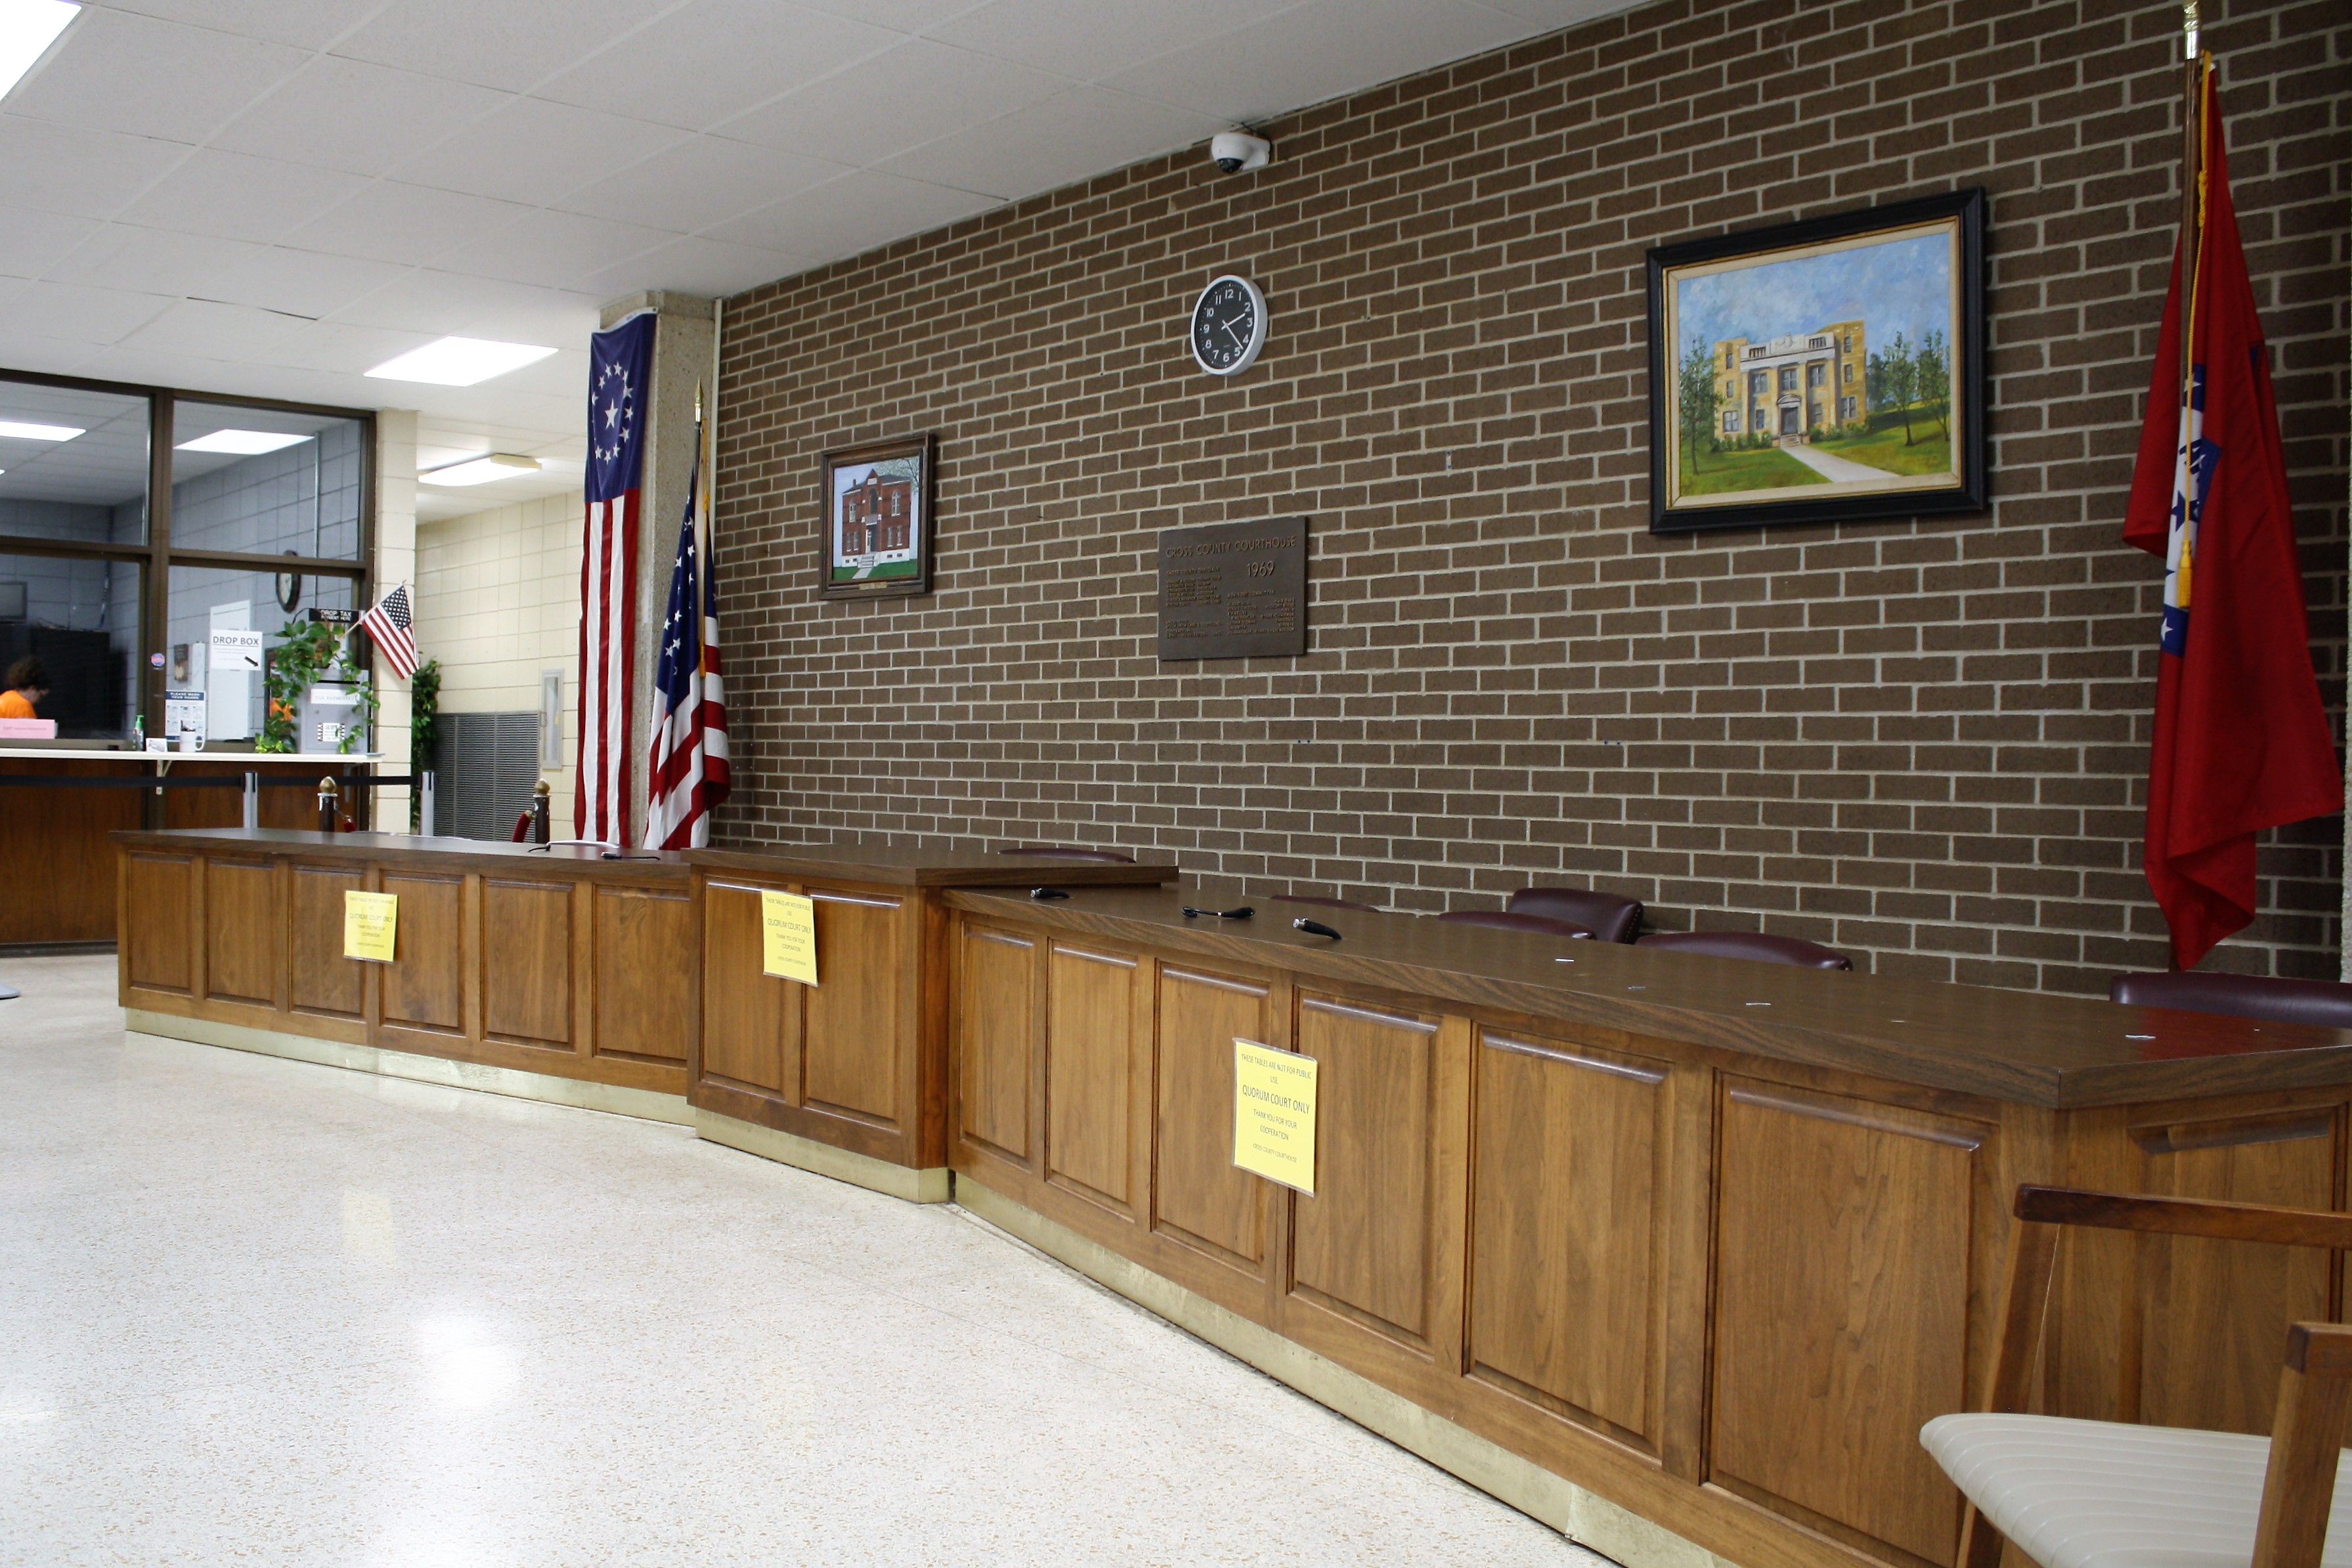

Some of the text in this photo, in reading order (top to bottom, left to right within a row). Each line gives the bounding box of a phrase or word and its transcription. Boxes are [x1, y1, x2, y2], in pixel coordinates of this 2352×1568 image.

[1225, 289, 1234, 299] 12
[1215, 295, 1221, 305] 11
[1244, 302, 1251, 312] 2
[1206, 308, 1214, 318] 10
[1247, 318, 1253, 327] 3
[1204, 324, 1209, 333] 9
[1242, 334, 1249, 343] 4
[1205, 339, 1211, 349] 8
[1213, 349, 1219, 359] 7
[1234, 347, 1240, 357] 5
[1223, 353, 1229, 362] 6
[1166, 535, 1296, 557] CROSS COUNTY COURTHOUSE
[1247, 561, 1275, 577] 1969
[768, 918, 811, 934] QUORUM COURT ONLY
[1241, 1054, 1254, 1064] THESE
[1254, 1057, 1268, 1068] TABLES
[1277, 1063, 1286, 1073] NOT
[1286, 1066, 1296, 1075] FOR
[1296, 1068, 1311, 1079] PUBLIC
[1242, 1085, 1310, 1115] QUORUM COURT ONLY
[1253, 1108, 1297, 1129] THANK YOU FOR YOUR
[1260, 1125, 1289, 1141] COOPERATION
